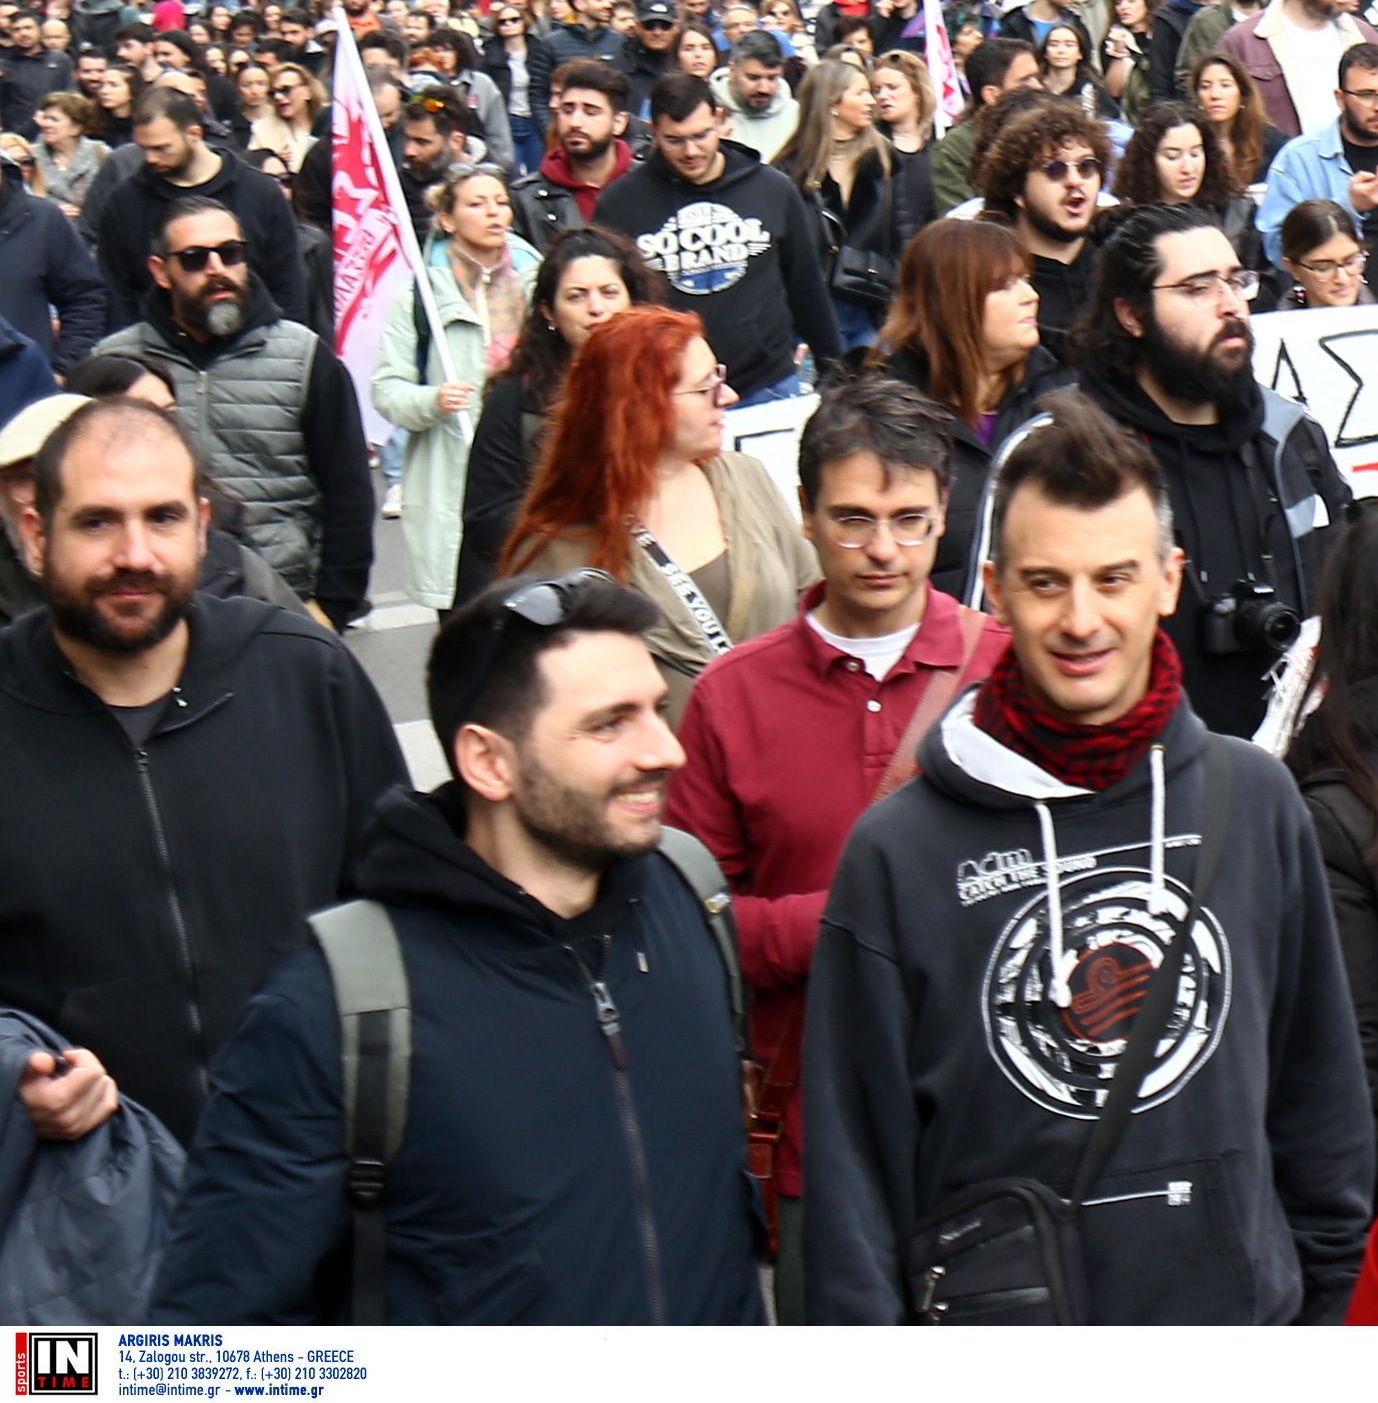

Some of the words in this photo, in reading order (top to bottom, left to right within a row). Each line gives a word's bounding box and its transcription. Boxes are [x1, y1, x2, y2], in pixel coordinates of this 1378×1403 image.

[637, 232, 679, 259] SO
[679, 218, 771, 251] COOL
[689, 596, 721, 634] YOU
